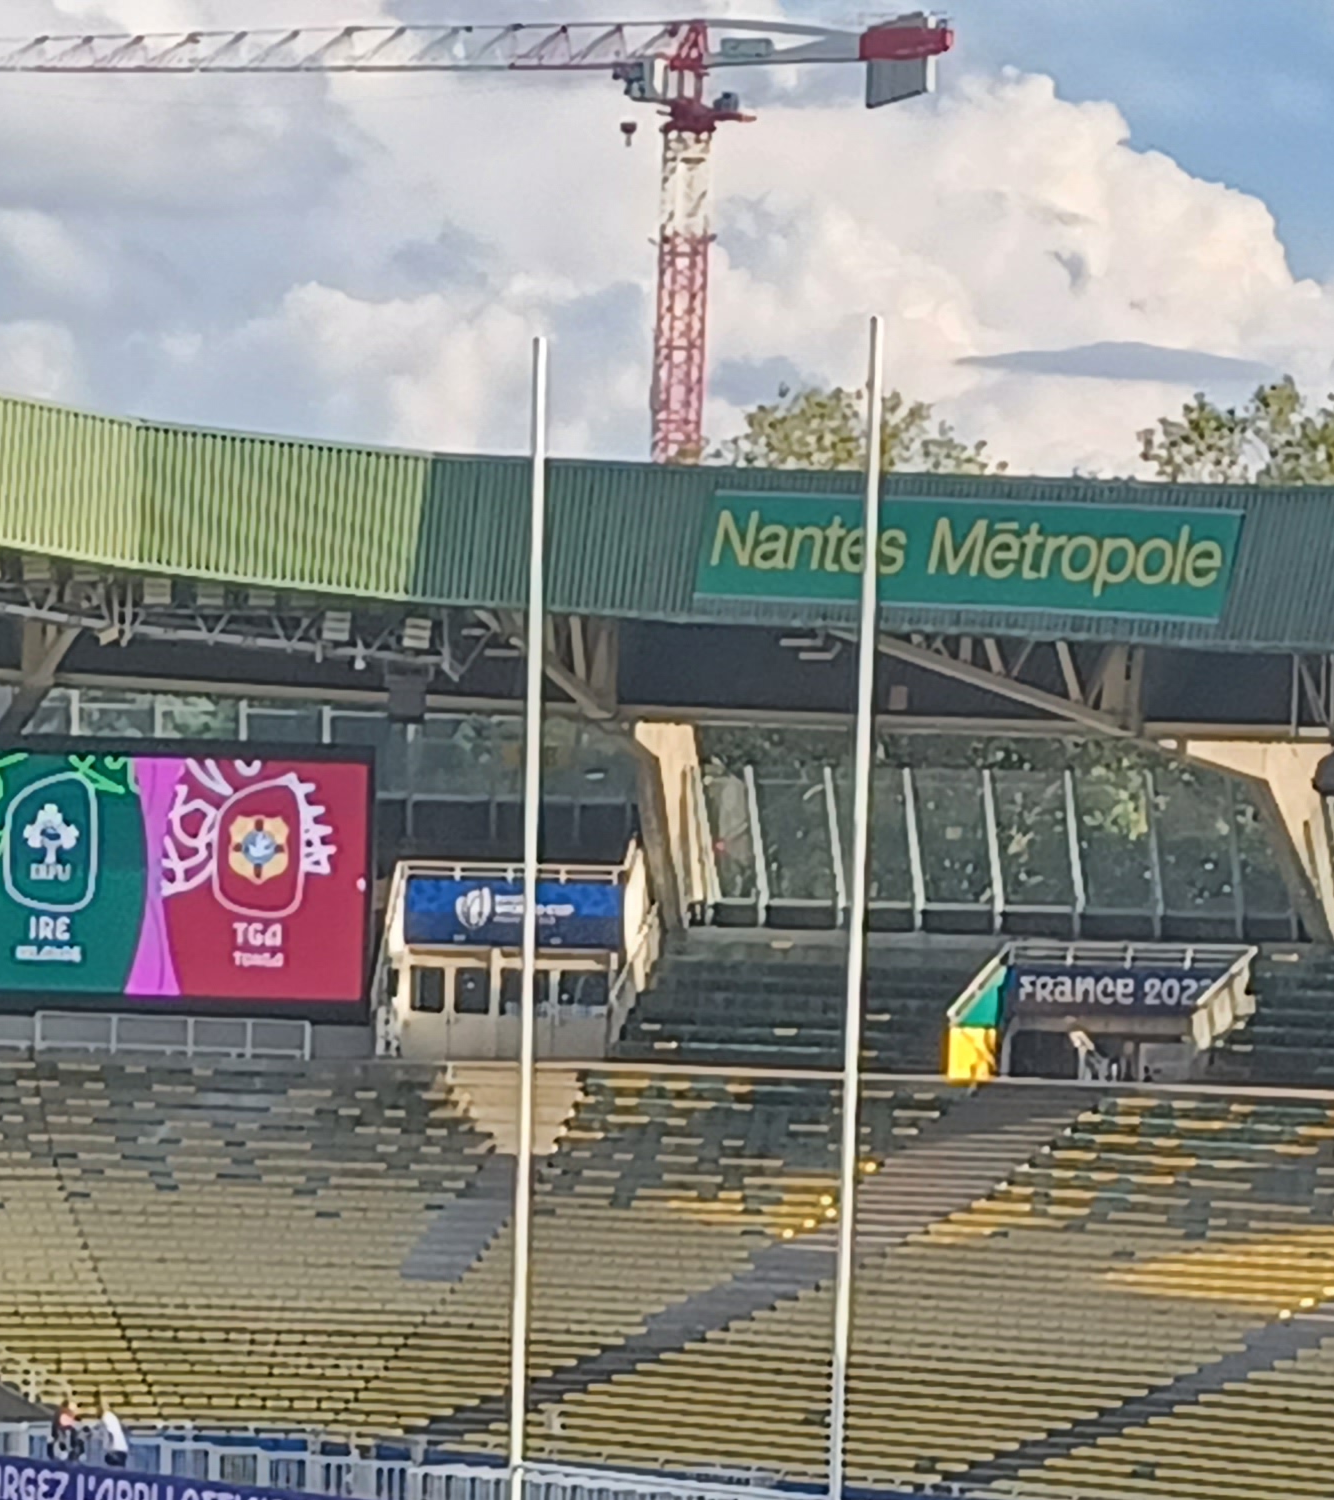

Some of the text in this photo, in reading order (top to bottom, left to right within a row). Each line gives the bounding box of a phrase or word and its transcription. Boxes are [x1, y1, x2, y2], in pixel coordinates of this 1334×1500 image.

[710, 508, 1223, 598] Nantes Métropole
[29, 915, 71, 940] IRE
[232, 922, 283, 947] TGA
